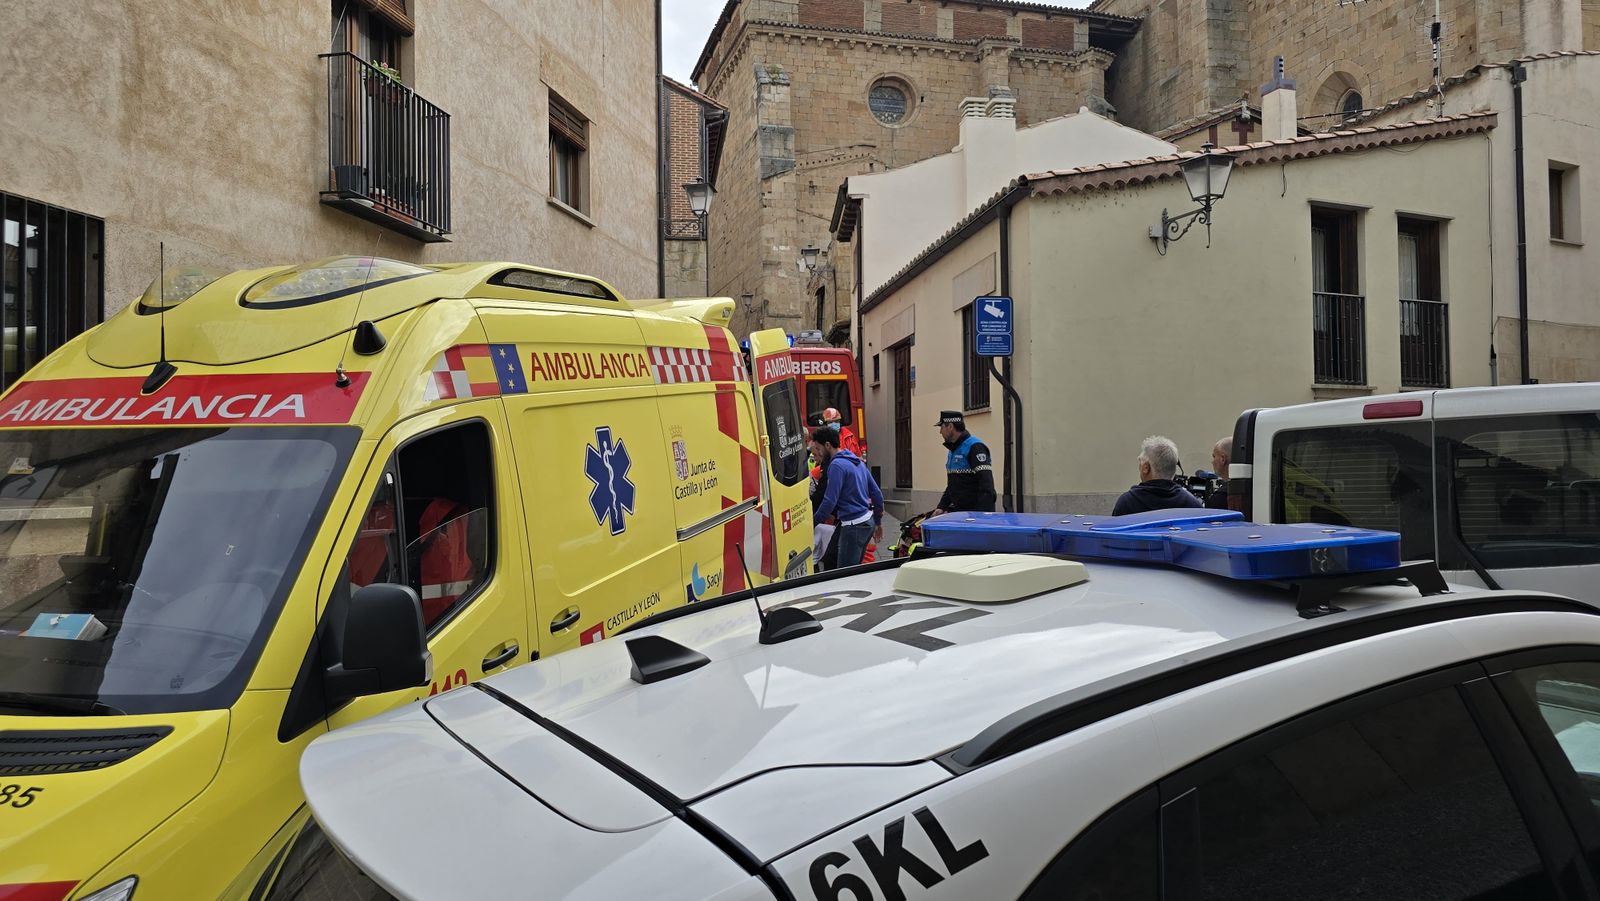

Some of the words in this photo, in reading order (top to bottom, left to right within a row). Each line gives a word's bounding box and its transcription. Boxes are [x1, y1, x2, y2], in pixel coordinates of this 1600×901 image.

[531, 352, 650, 382] AMBULANCIA
[792, 361, 841, 375] BEROS
[0, 394, 306, 421] AMBULANCIA
[690, 461, 708, 477] Junta
[708, 459, 716, 471] de
[675, 483, 698, 500] Castilla
[699, 482, 704, 496] y
[704, 476, 718, 490] León
[706, 568, 722, 589] Sacyl
[607, 605, 638, 630] CASTILLA
[638, 601, 643, 613] Y
[644, 592, 660, 610] LEÓN
[0, 784, 45, 808] 85
[809, 805, 990, 901] 6KL
